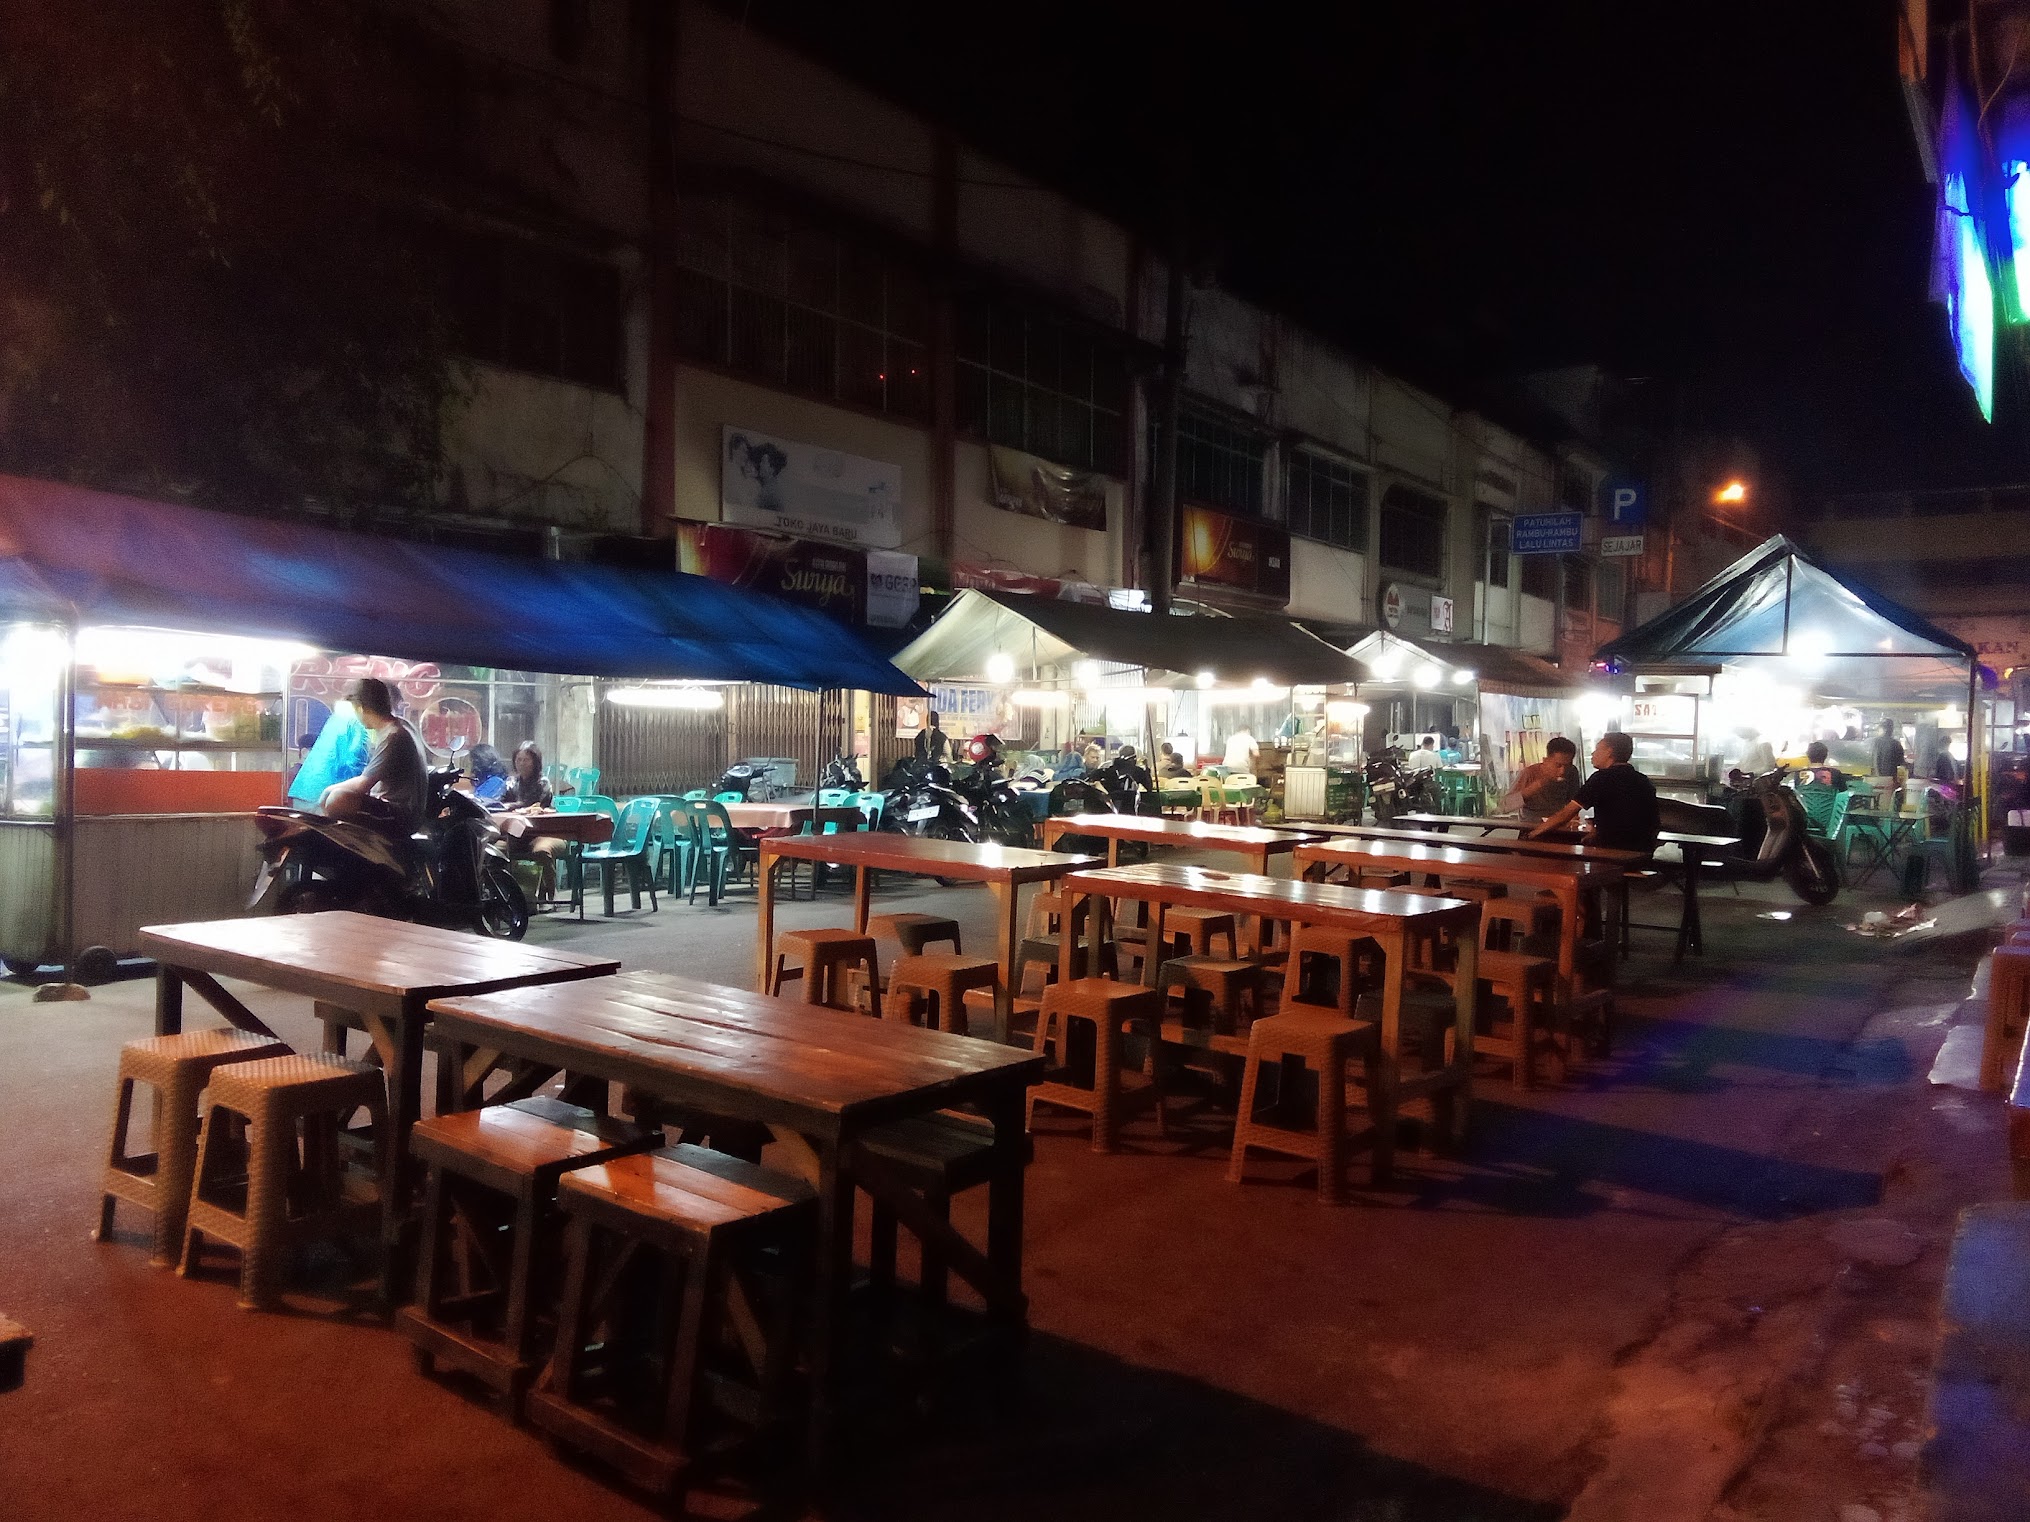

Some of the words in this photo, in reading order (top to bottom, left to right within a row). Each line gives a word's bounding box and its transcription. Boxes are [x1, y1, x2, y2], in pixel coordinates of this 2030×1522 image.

[1613, 488, 1637, 521] P
[776, 516, 803, 529] TOKO
[806, 520, 830, 534] JAYA
[832, 525, 857, 540] BARU
[1523, 517, 1573, 527] PATUHILAH
[1516, 527, 1579, 539] RAMBU-RAMBU
[1519, 539, 1542, 550] LALU
[1543, 538, 1574, 548] LINTAS
[1603, 539, 1642, 554] SEJAJAR
[781, 557, 855, 606] Surya
